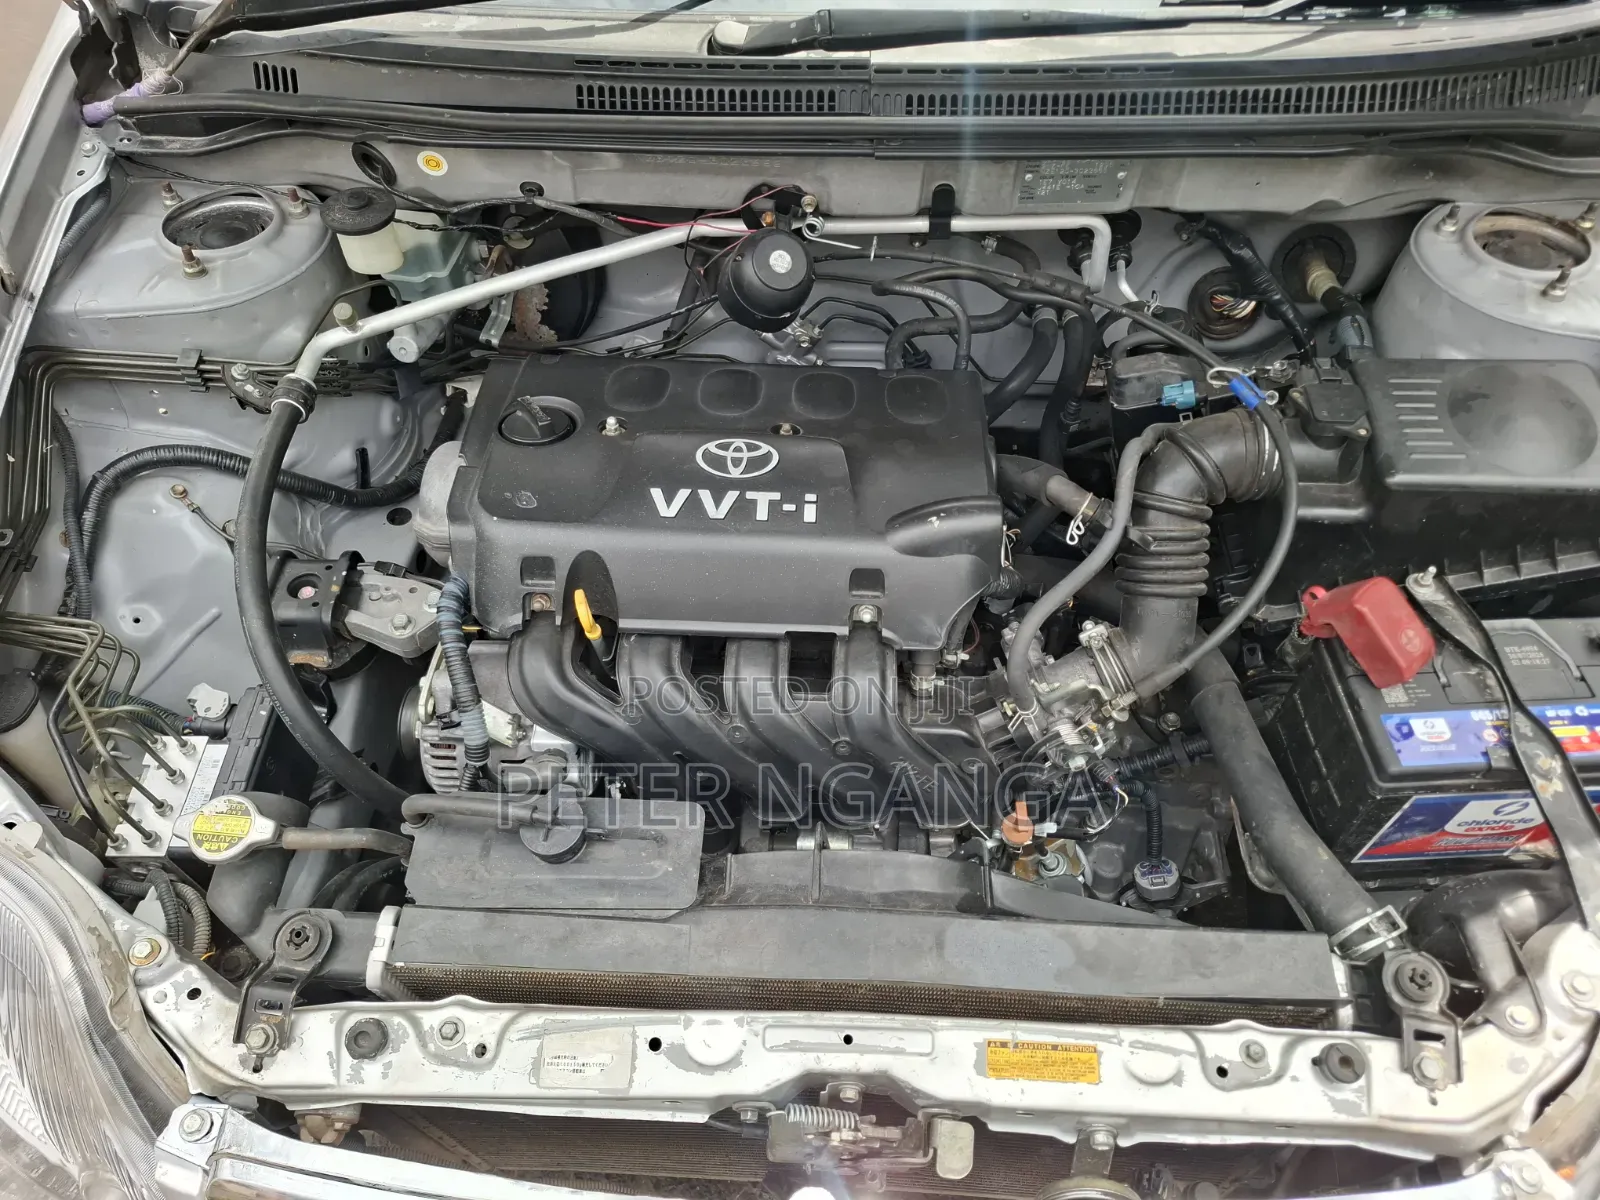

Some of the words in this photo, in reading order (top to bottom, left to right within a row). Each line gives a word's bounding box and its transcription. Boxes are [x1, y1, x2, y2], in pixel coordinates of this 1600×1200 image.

[650, 487, 818, 524] VVT-i
[1457, 818, 1535, 827] chloride
[1463, 824, 1516, 833] exide
[196, 833, 239, 844] CAUTION
[1018, 1042, 1052, 1050] CAUTION
[1057, 1044, 1096, 1053] ATTENTION
